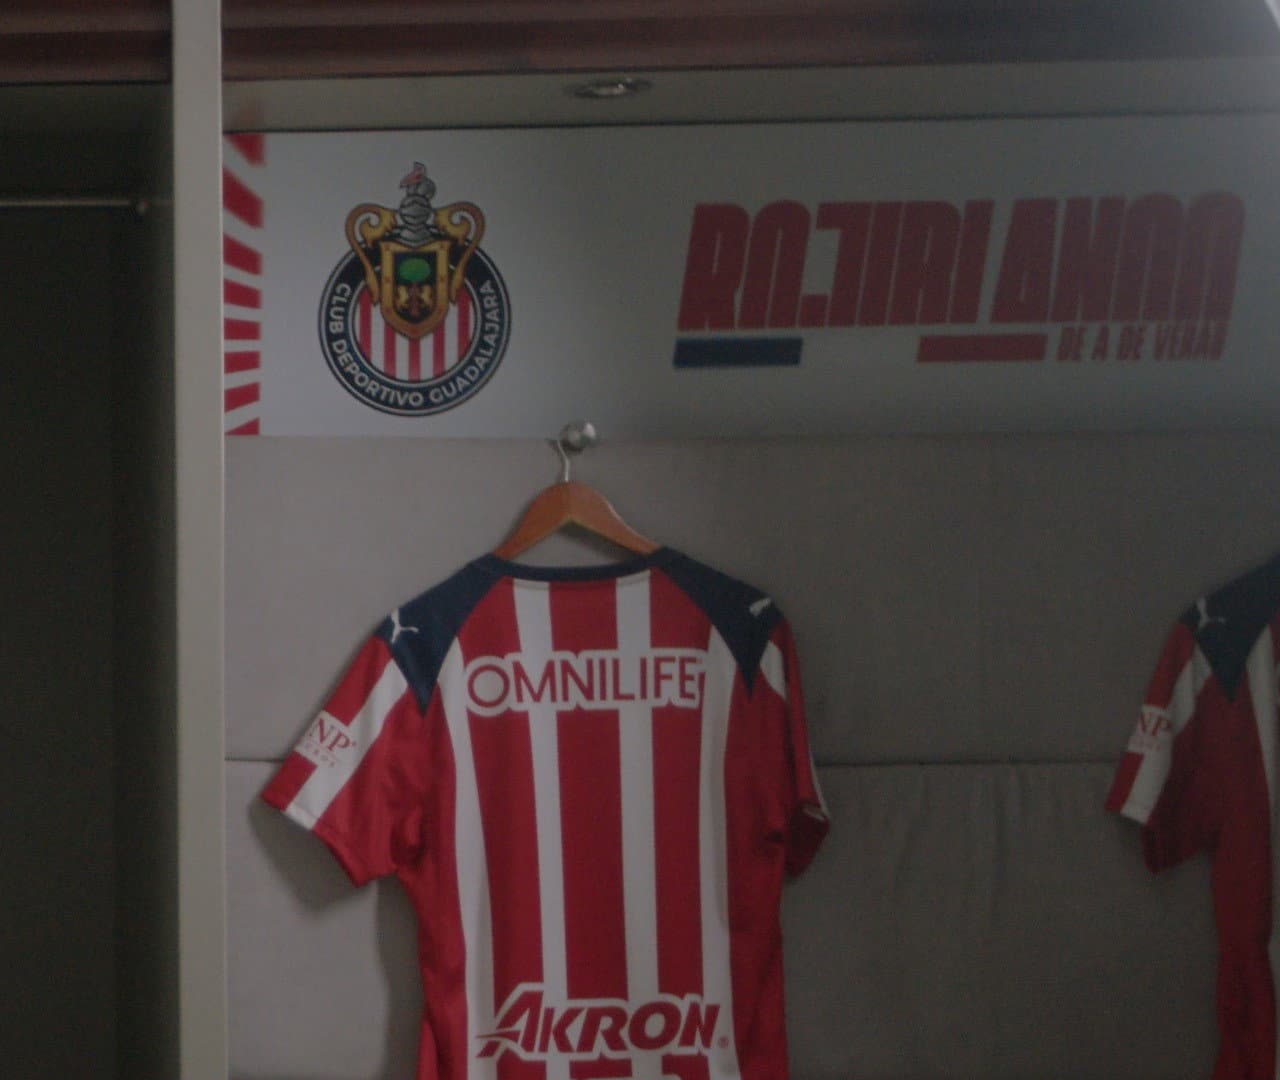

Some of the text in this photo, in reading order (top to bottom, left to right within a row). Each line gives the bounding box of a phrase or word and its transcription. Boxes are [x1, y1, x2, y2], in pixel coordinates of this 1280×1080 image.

[328, 280, 503, 407] CLUB DEPORTIVO GUADALAJARA
[469, 657, 698, 706] OMNILIFE
[476, 991, 720, 1058] AKRON
